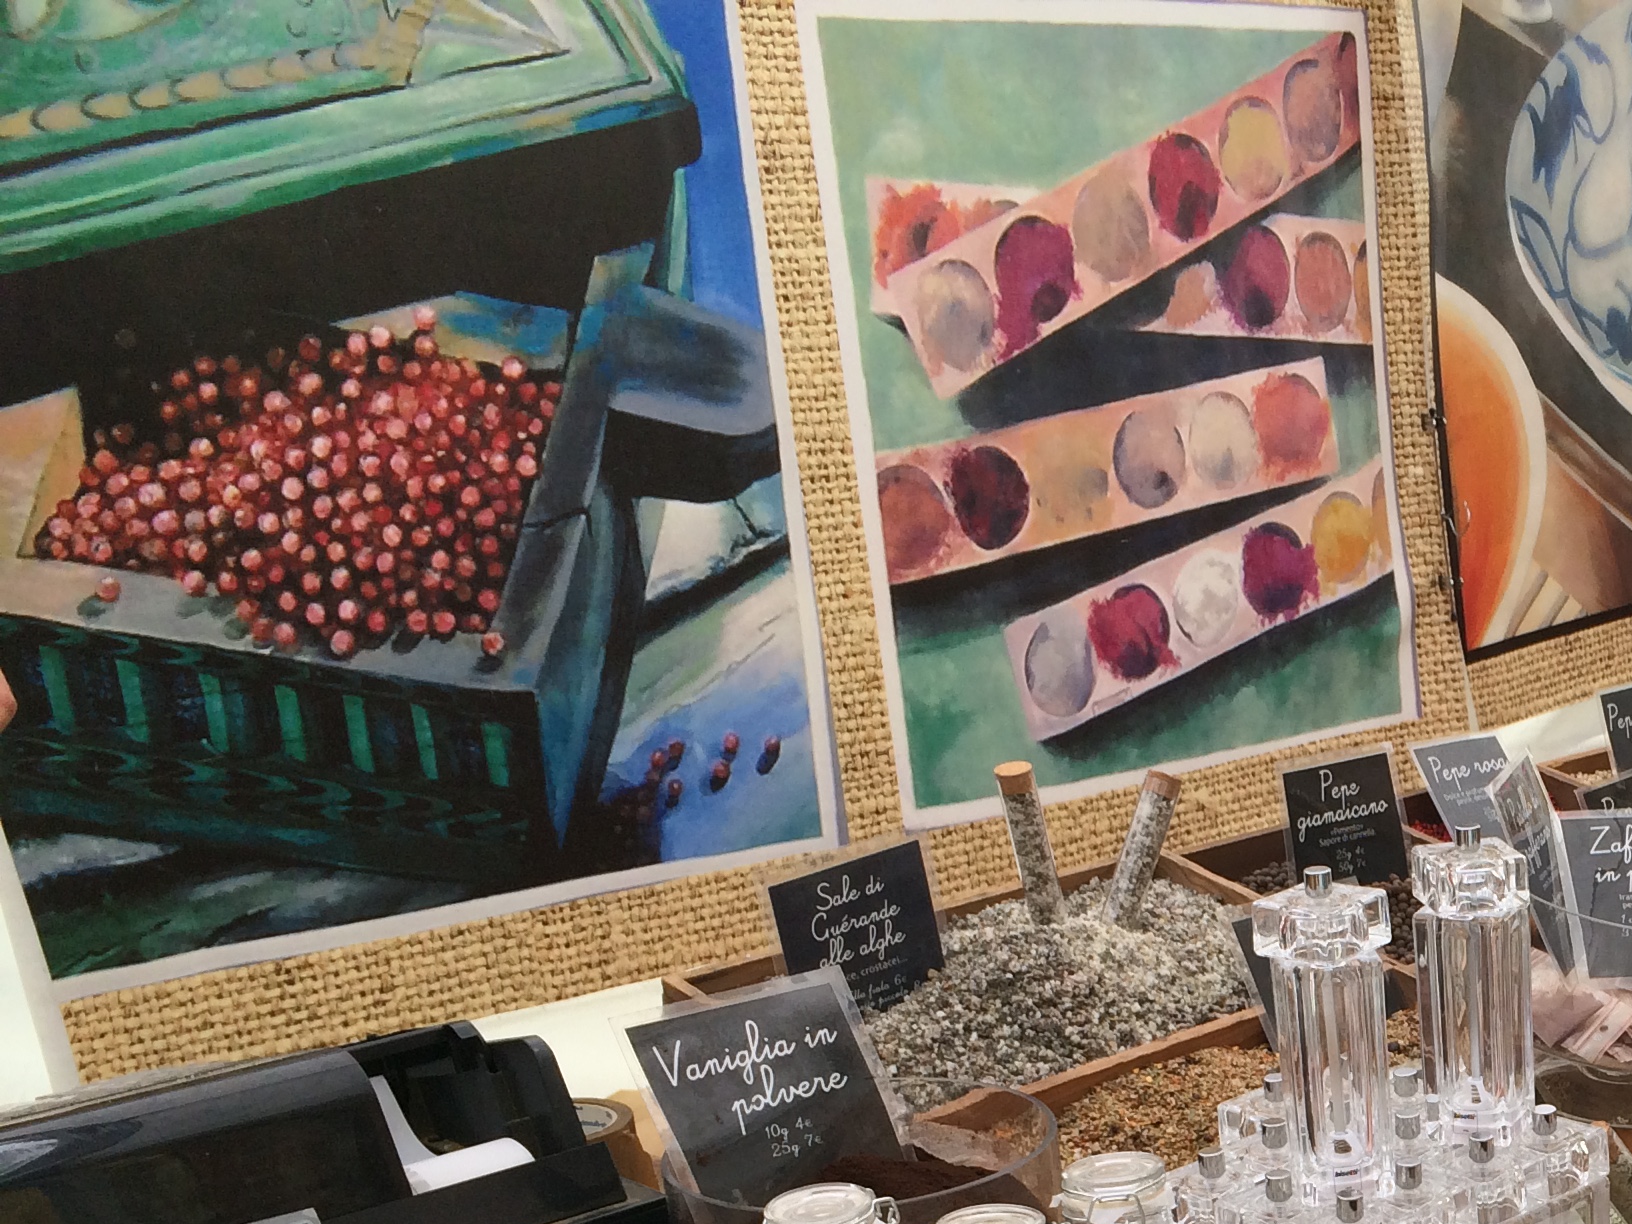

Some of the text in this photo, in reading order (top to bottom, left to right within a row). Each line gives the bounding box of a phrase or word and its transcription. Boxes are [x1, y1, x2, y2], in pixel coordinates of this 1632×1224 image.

[1319, 769, 1361, 810] Pepe
[1428, 755, 1508, 792] Pepe rosa
[1297, 799, 1389, 843] giamaicano
[815, 874, 885, 913] Sale di
[1594, 867, 1622, 884] in
[810, 902, 902, 942] Guérande
[819, 924, 907, 970] alle alghe
[652, 1019, 839, 1088] Vaniglia in
[731, 1063, 850, 1137] polvere
[764, 1116, 815, 1143] 10g 4€
[803, 1132, 824, 1148] 7€
